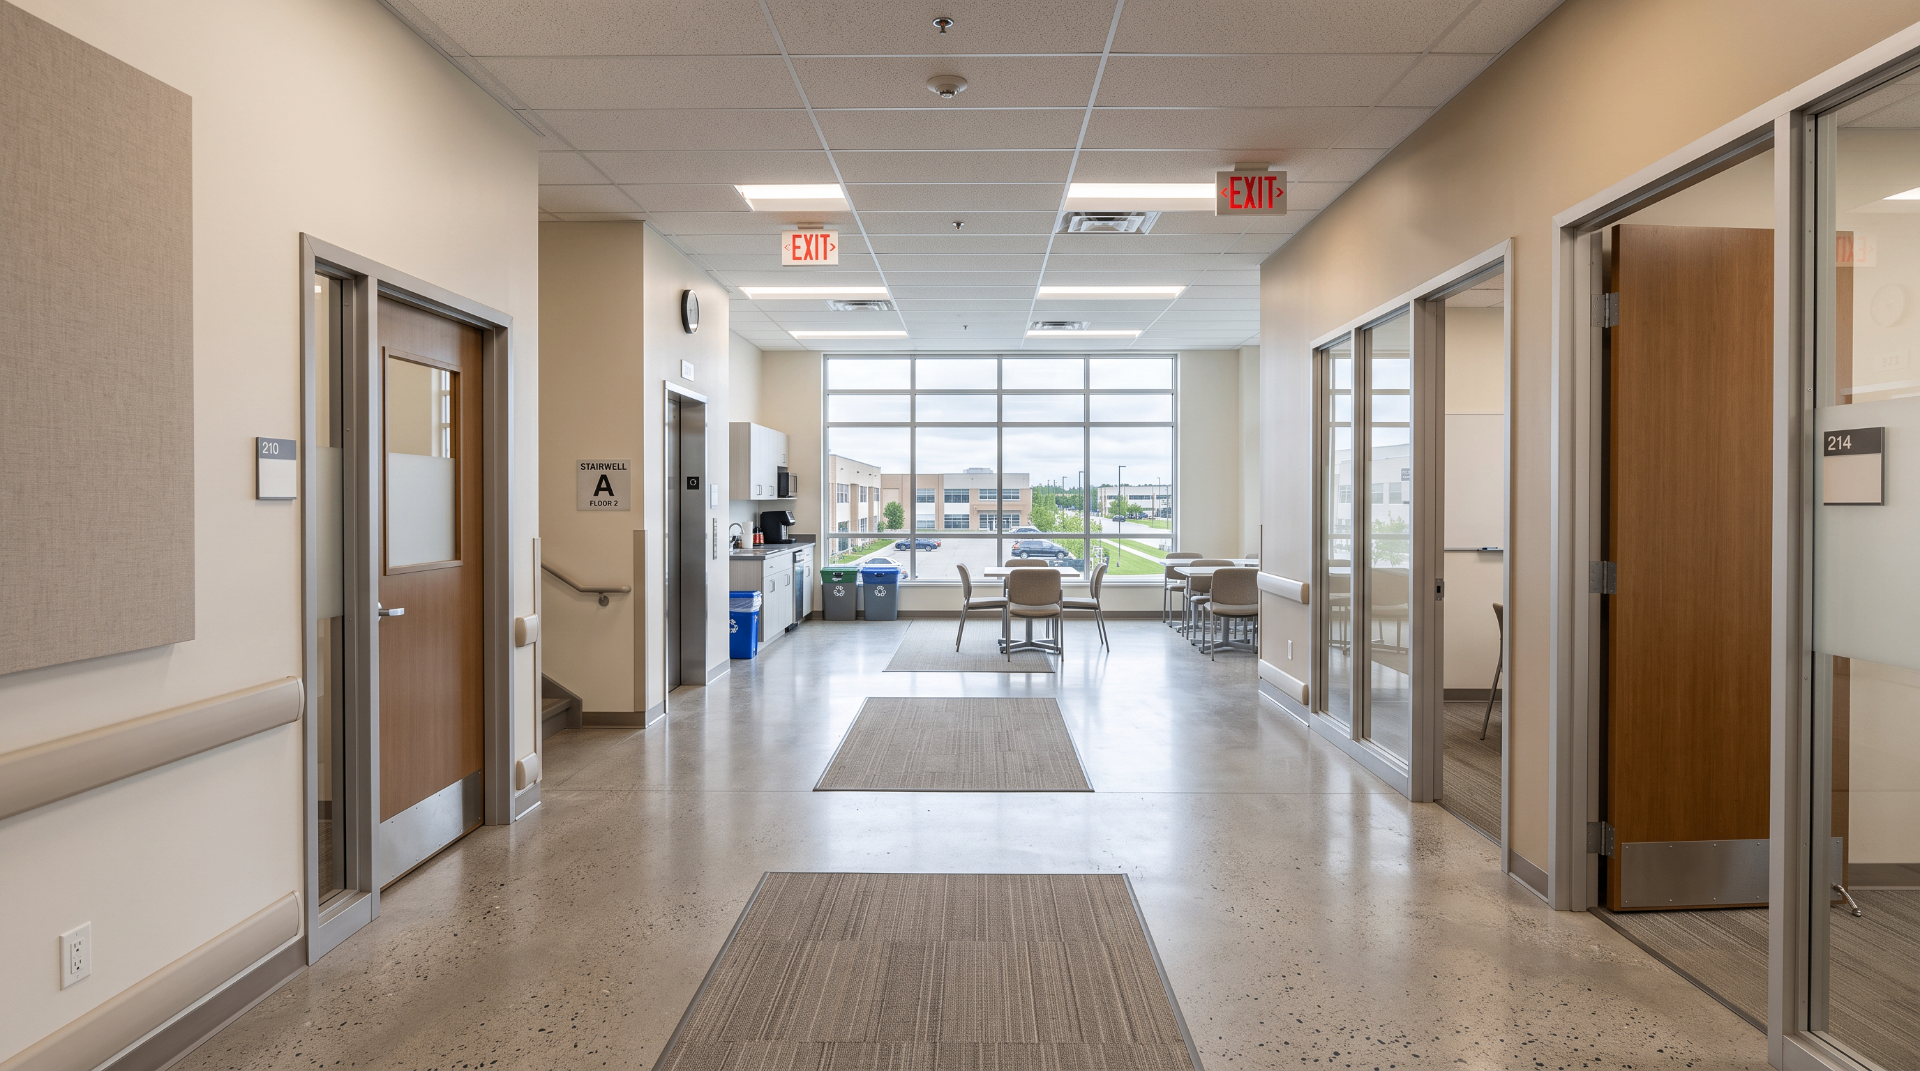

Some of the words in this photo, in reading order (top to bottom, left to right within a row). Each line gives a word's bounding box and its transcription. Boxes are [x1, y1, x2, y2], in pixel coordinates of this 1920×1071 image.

[1229, 176, 1277, 209] EXIT
[792, 234, 831, 260] EXIT
[262, 441, 279, 455] 210
[1827, 434, 1852, 451] 214
[580, 462, 627, 471] STAIRWELL
[593, 474, 615, 497] A
